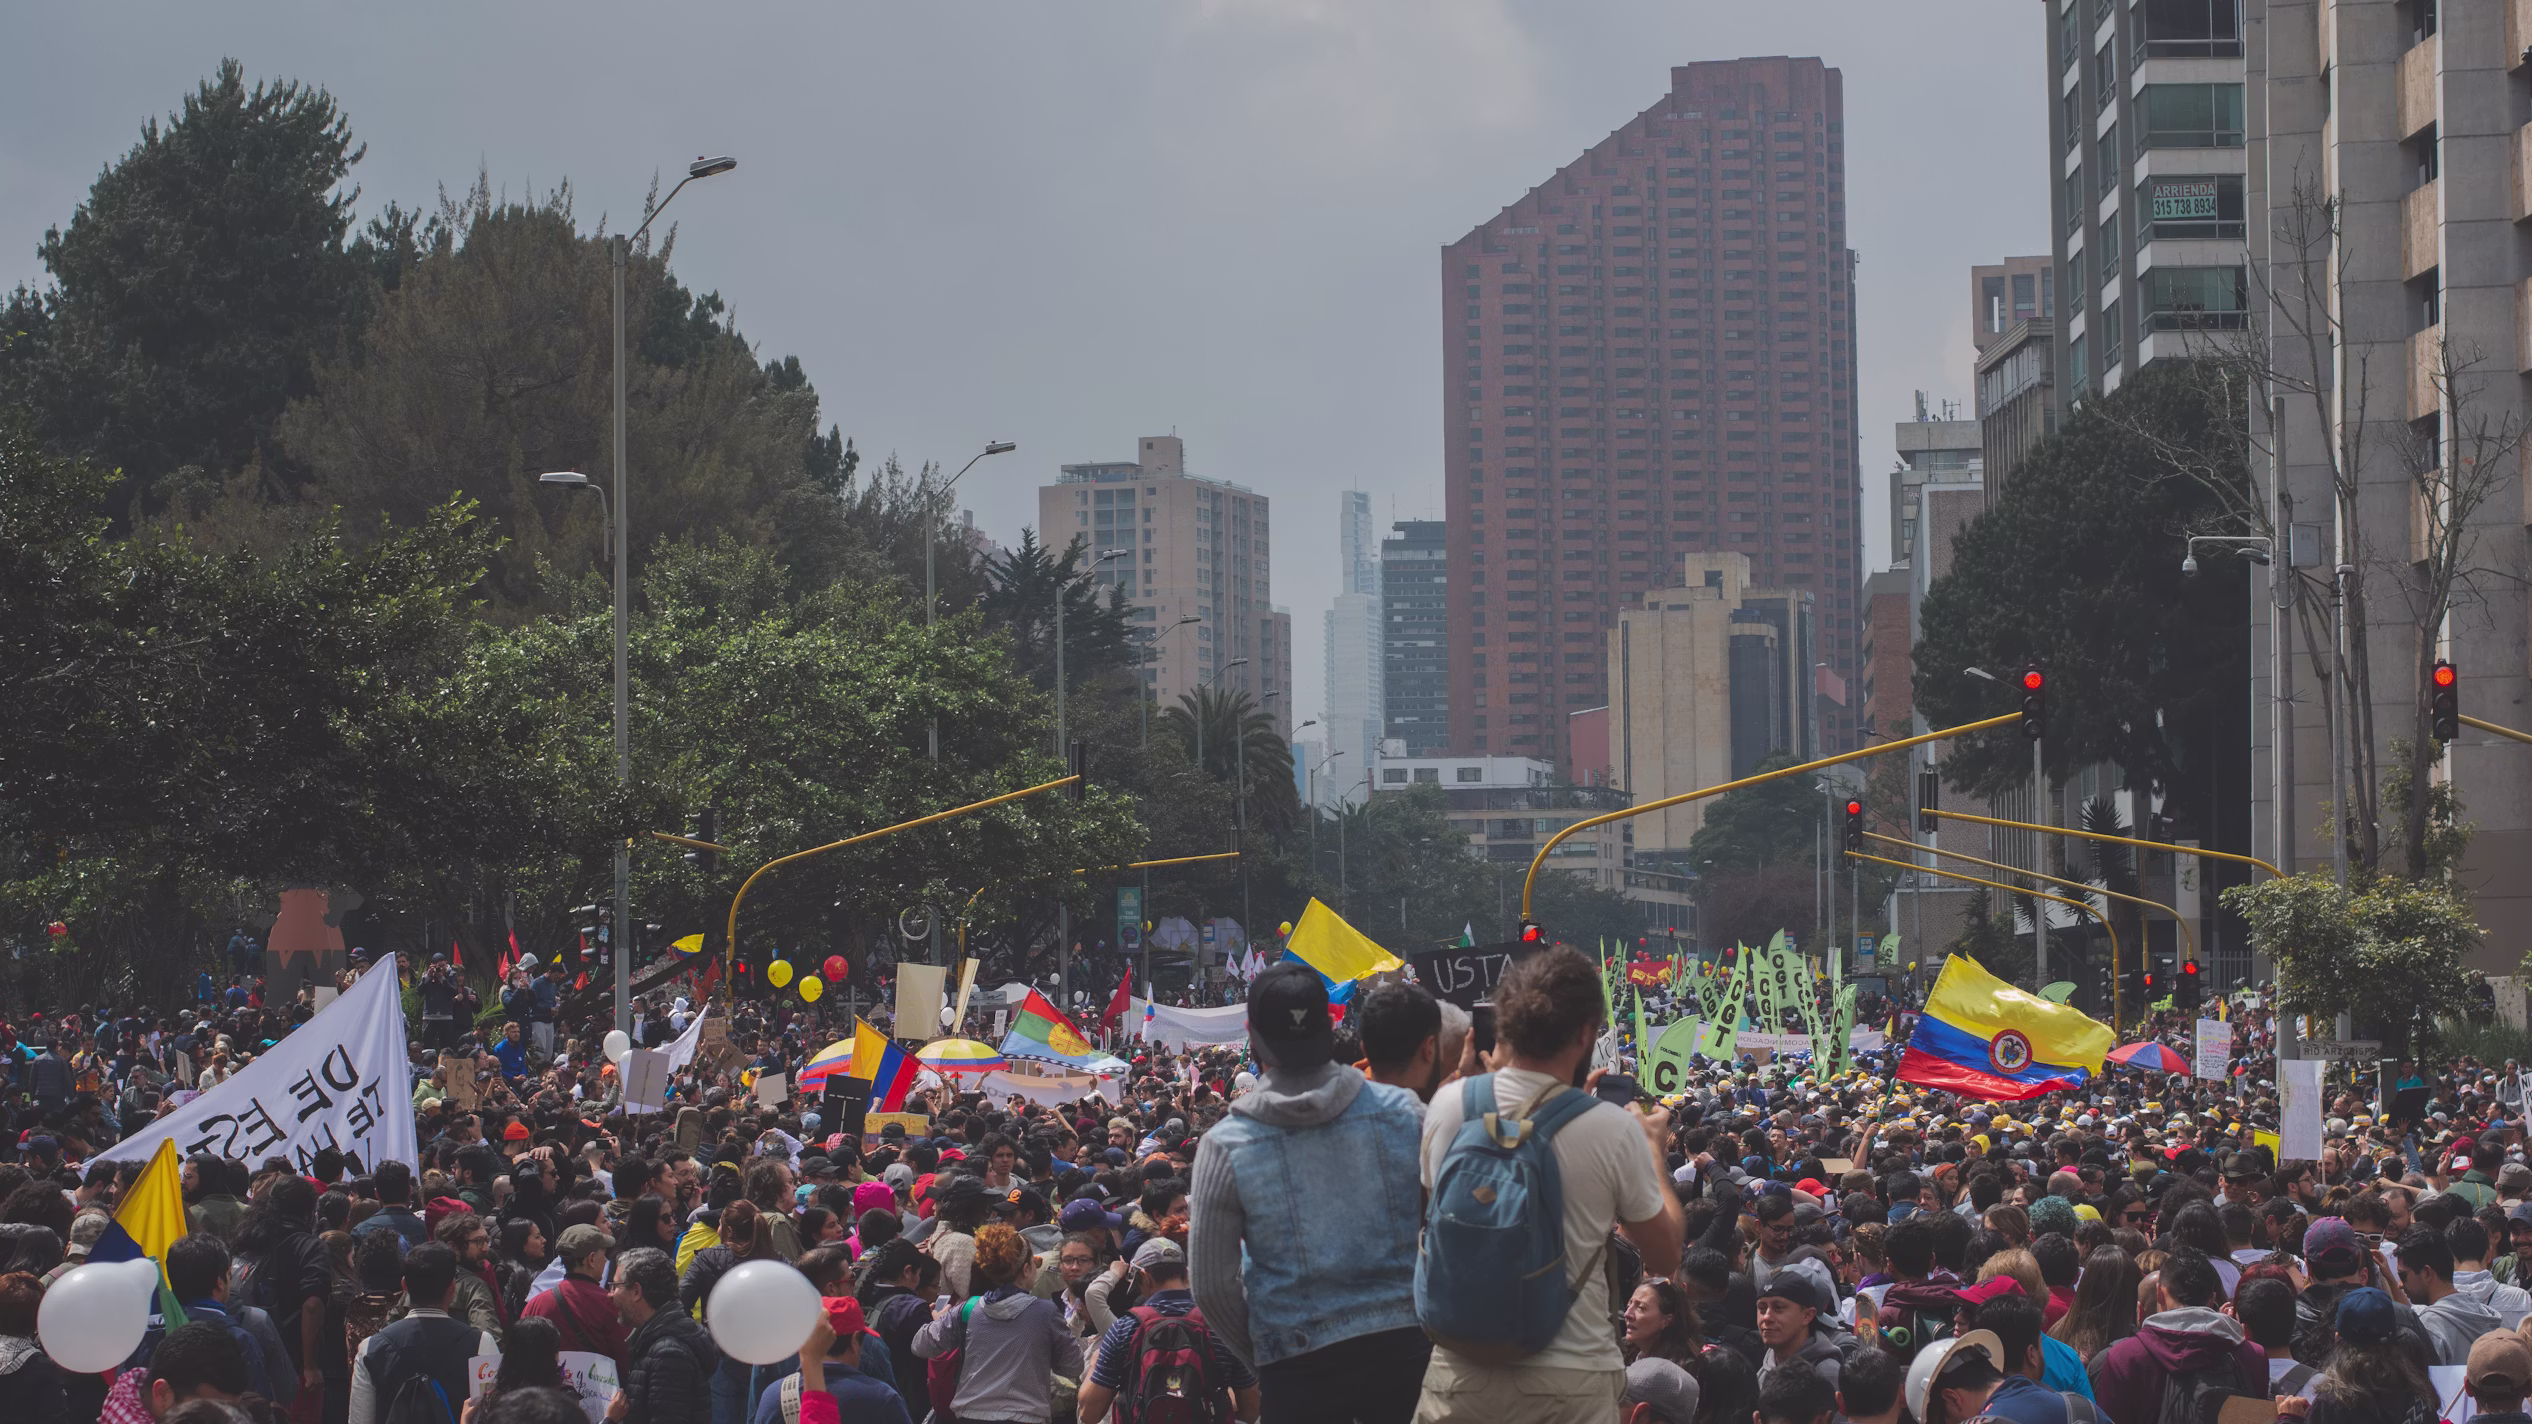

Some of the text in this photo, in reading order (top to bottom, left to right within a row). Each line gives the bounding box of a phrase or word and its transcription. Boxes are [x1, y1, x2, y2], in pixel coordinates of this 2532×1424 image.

[2154, 184, 2215, 197] ARRIENDA
[2154, 197, 2216, 215] 315 738 8934
[1715, 979, 1743, 1047] CGT
[1760, 978, 1773, 1034] CGT
